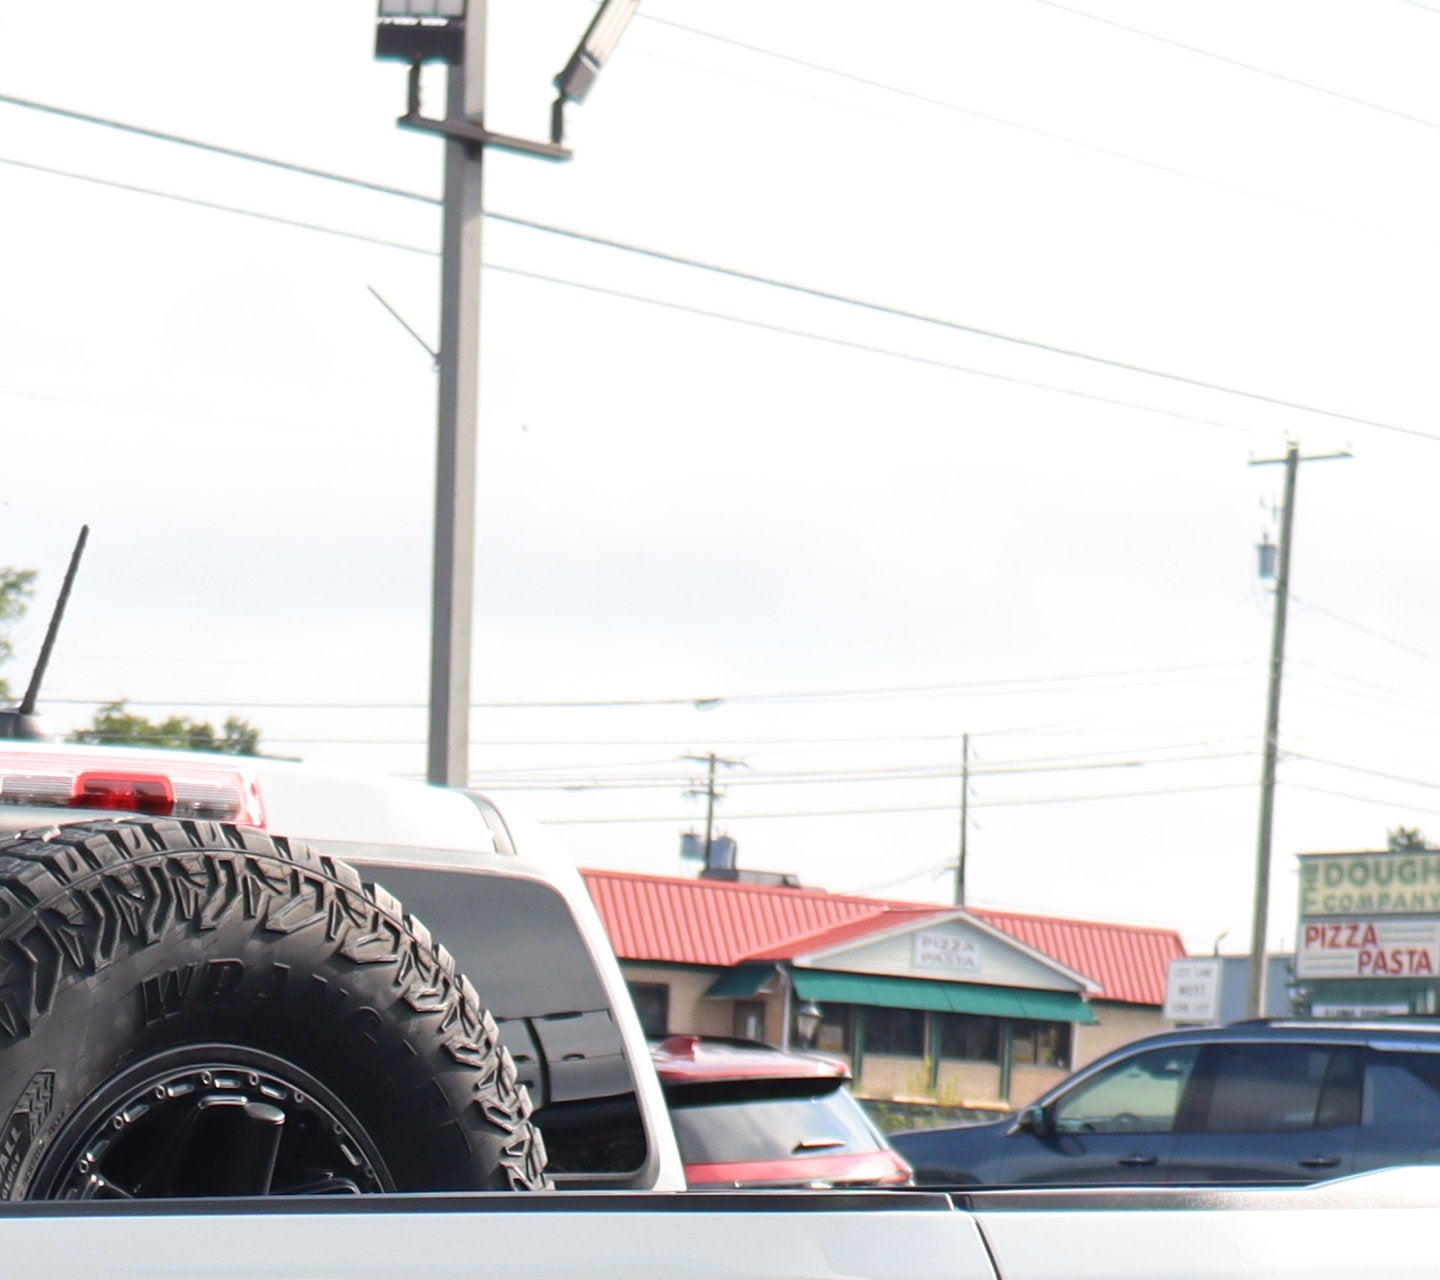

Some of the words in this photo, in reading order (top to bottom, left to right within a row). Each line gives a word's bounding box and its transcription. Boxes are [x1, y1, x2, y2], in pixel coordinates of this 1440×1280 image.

[921, 936, 975, 952] PIZZA
[1304, 922, 1379, 950] PIZZA
[1356, 948, 1434, 976] PASTA
